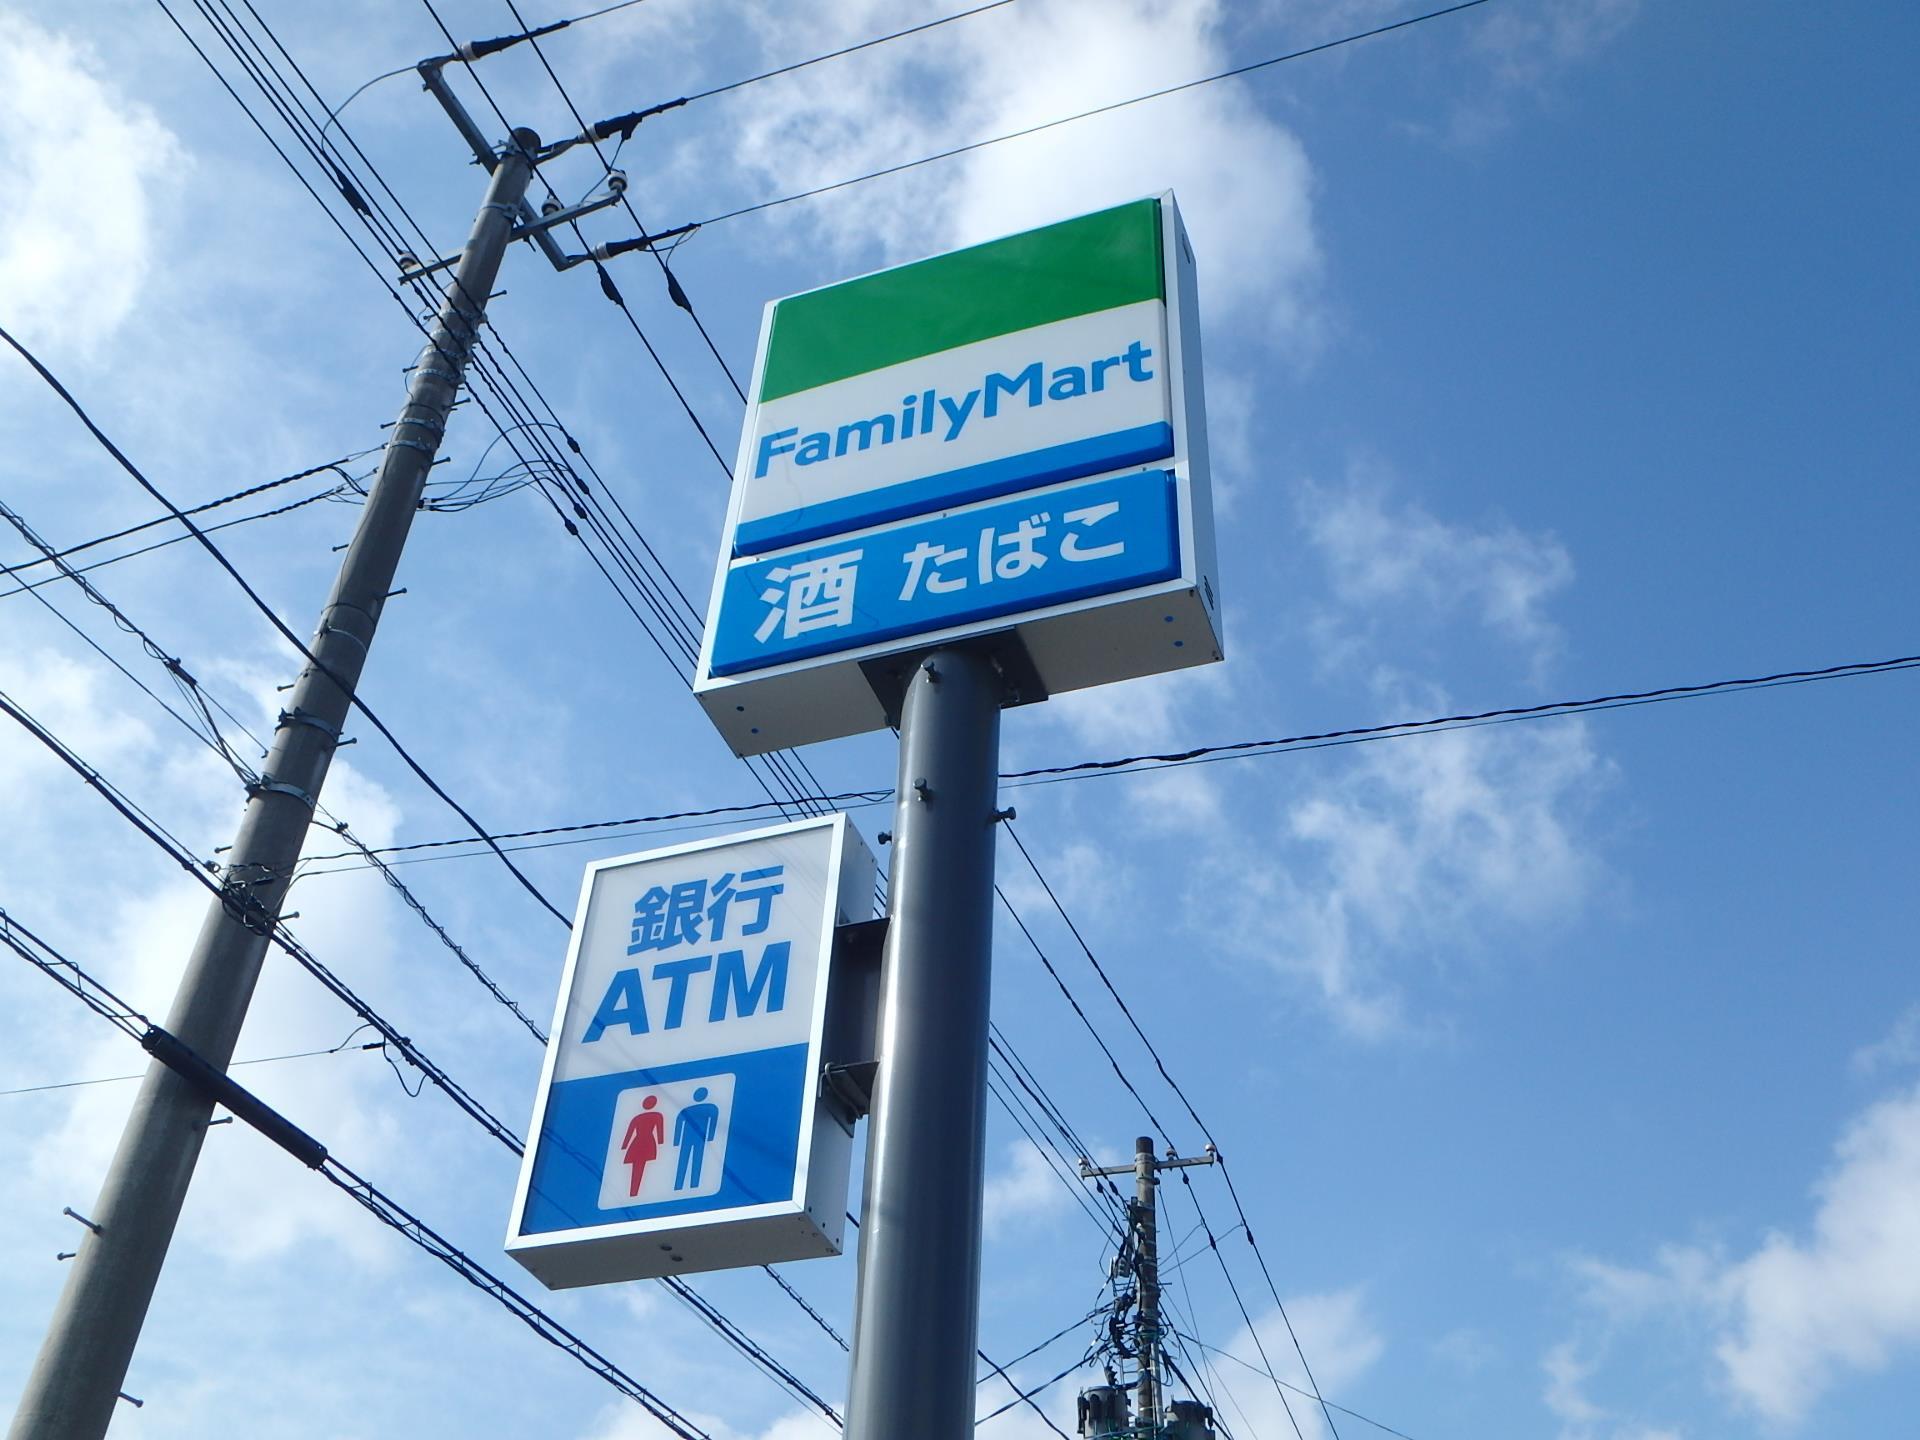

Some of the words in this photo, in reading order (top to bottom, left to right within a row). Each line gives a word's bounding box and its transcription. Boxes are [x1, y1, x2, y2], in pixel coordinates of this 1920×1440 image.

[755, 340, 1154, 478] FamilyMart
[754, 549, 863, 645] 酒
[899, 501, 1125, 602] たばこ
[627, 865, 785, 955] 銀行
[582, 941, 791, 1043] ATM
